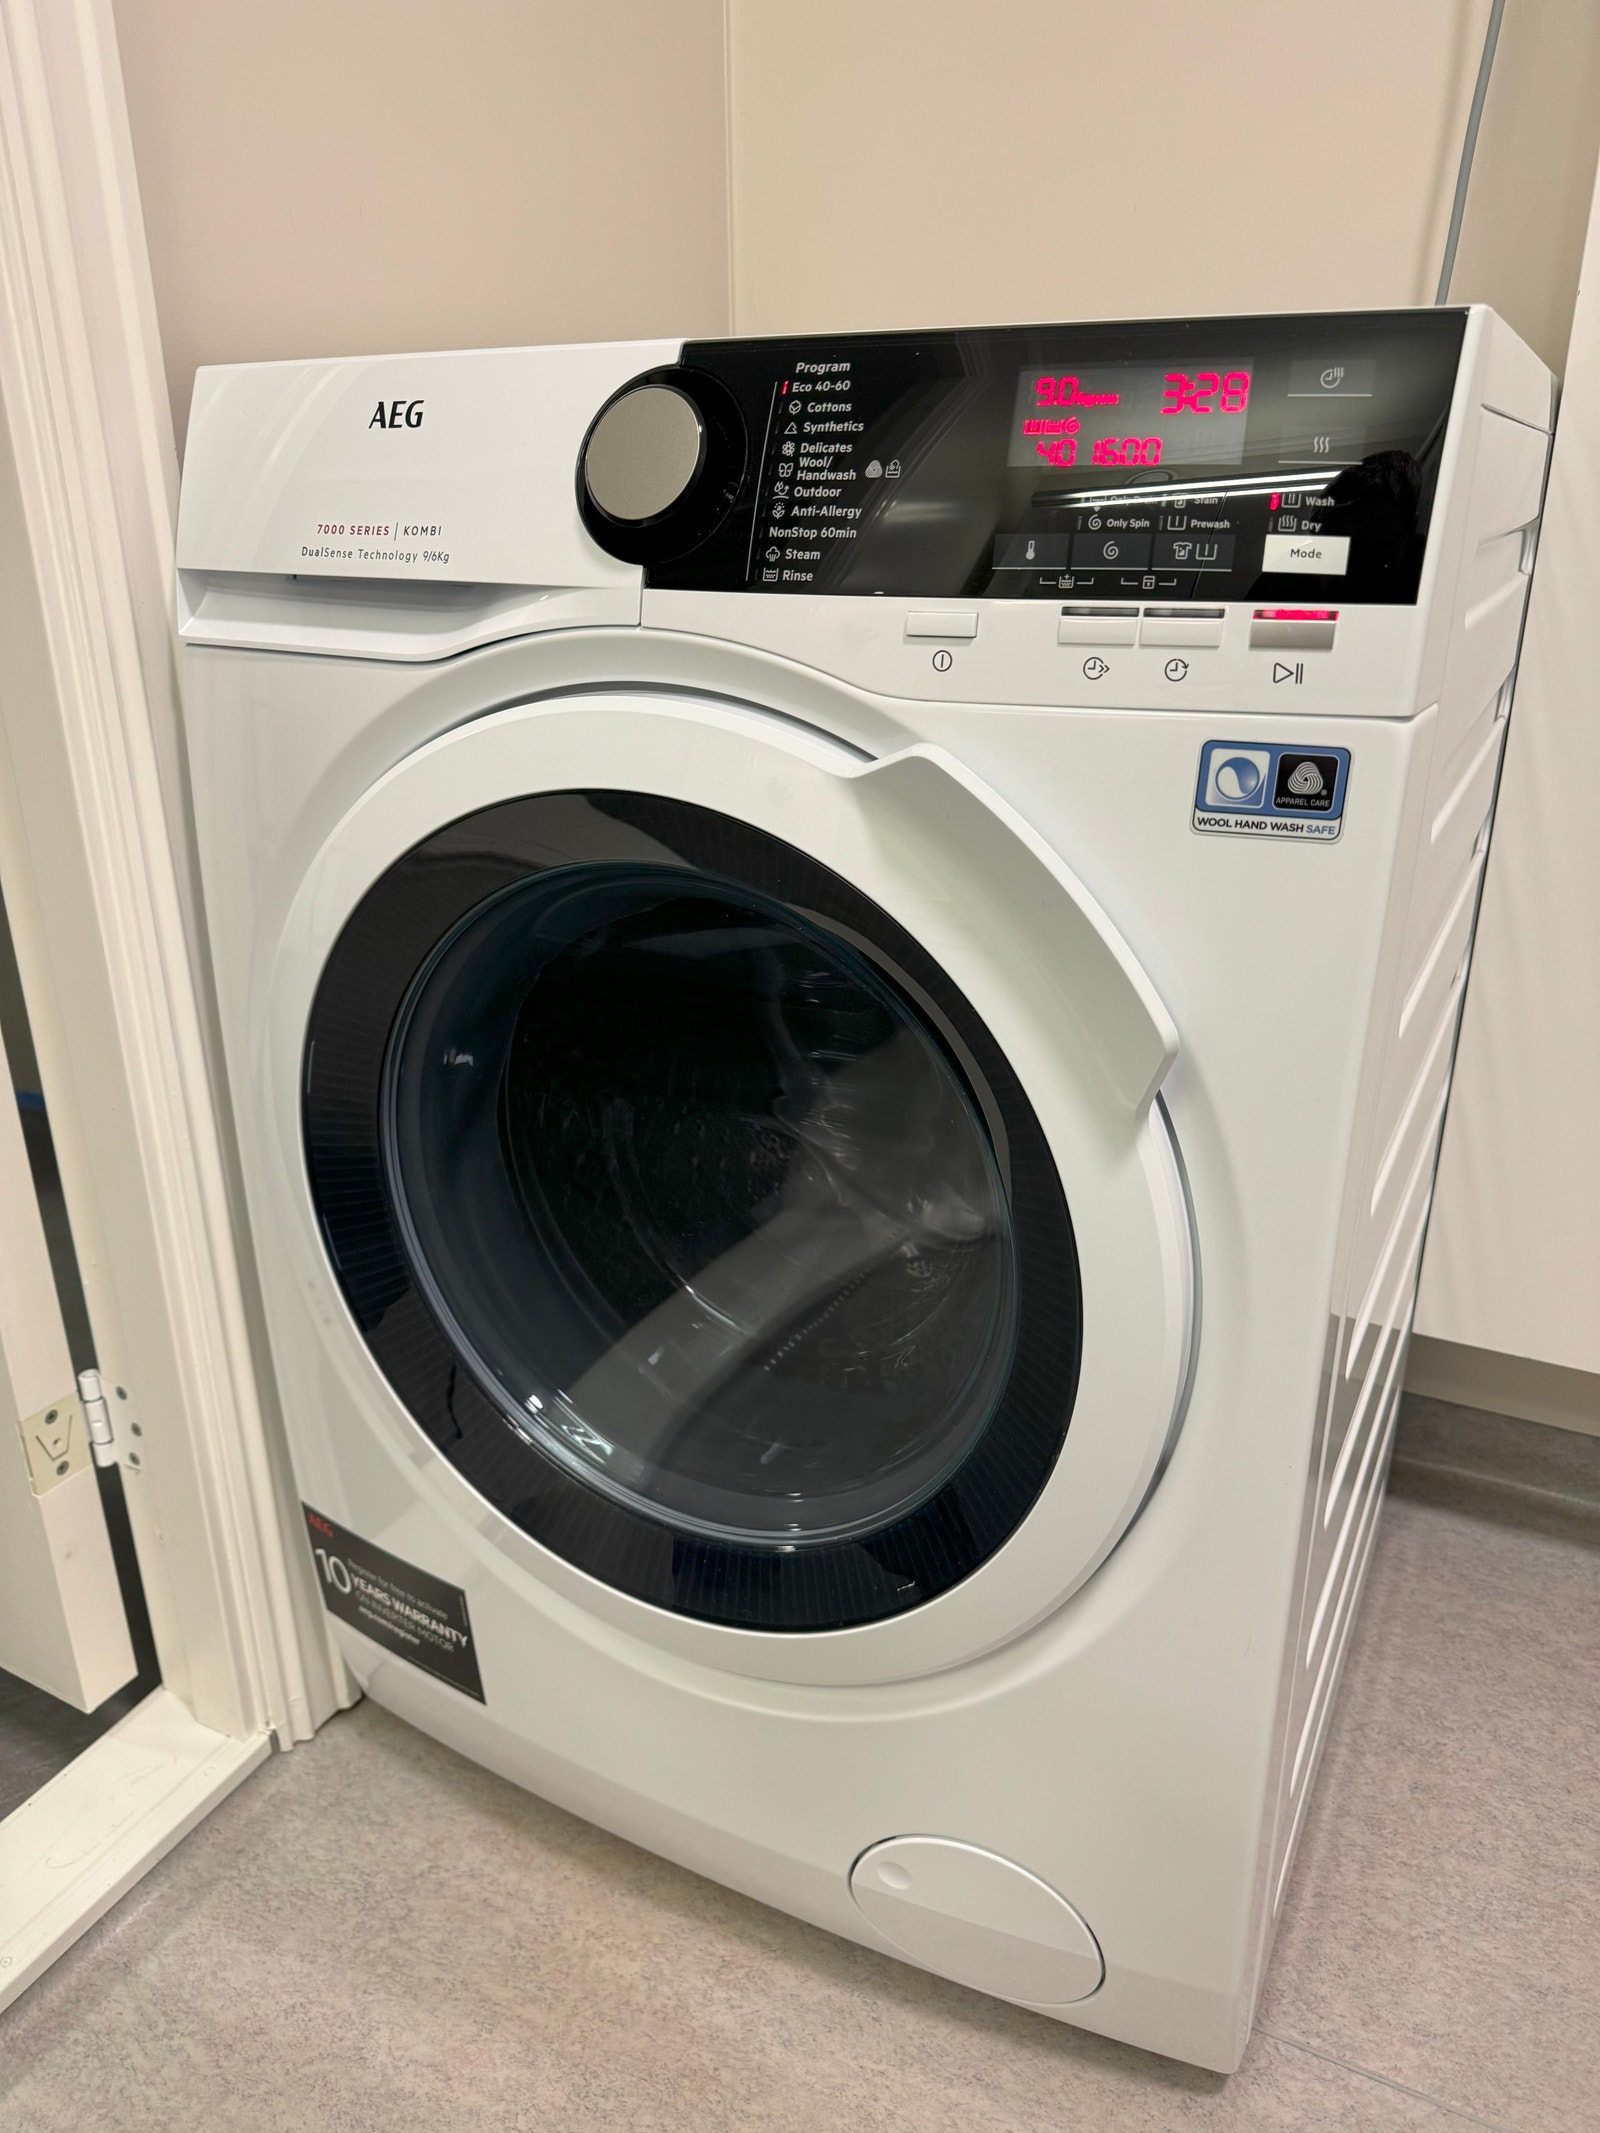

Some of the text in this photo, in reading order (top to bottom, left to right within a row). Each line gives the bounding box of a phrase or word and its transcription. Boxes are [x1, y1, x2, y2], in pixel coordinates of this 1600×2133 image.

[795, 362, 851, 375] Program
[792, 380, 851, 393] Eco 40-60
[1035, 376, 1079, 407] 9.0
[1160, 371, 1251, 414] 3:28
[807, 402, 852, 413] Cottons
[368, 399, 425, 429] AEG
[803, 421, 864, 435] Synthetics
[800, 442, 853, 454] Delicates
[1036, 436, 1163, 467] 40 1600
[799, 456, 833, 469] Wool/
[796, 469, 857, 481] Handwash
[794, 486, 842, 498] Outdoor
[1194, 494, 1219, 505] Stain
[1305, 496, 1335, 507] Wash
[790, 505, 863, 519] Anti-Allergy
[317, 524, 442, 536] 7000 SERIES KOMBI
[1106, 518, 1150, 530] Only Spin
[1190, 519, 1230, 529] Prewash
[1301, 520, 1322, 532] Dry
[768, 526, 857, 540] NonStop 60min
[301, 546, 450, 564] DualSense Technology 9/6Kg
[785, 548, 821, 560] Steam
[1290, 548, 1322, 559] Mode
[782, 570, 814, 582] Rinse
[1275, 796, 1330, 807] APPAREL CARE
[1197, 817, 1336, 835] WOOL HAND WASH SAFE
[315, 1548, 351, 1594] 10
[350, 1573, 391, 1606] YEARS
[391, 1596, 468, 1648] WARRANTY
